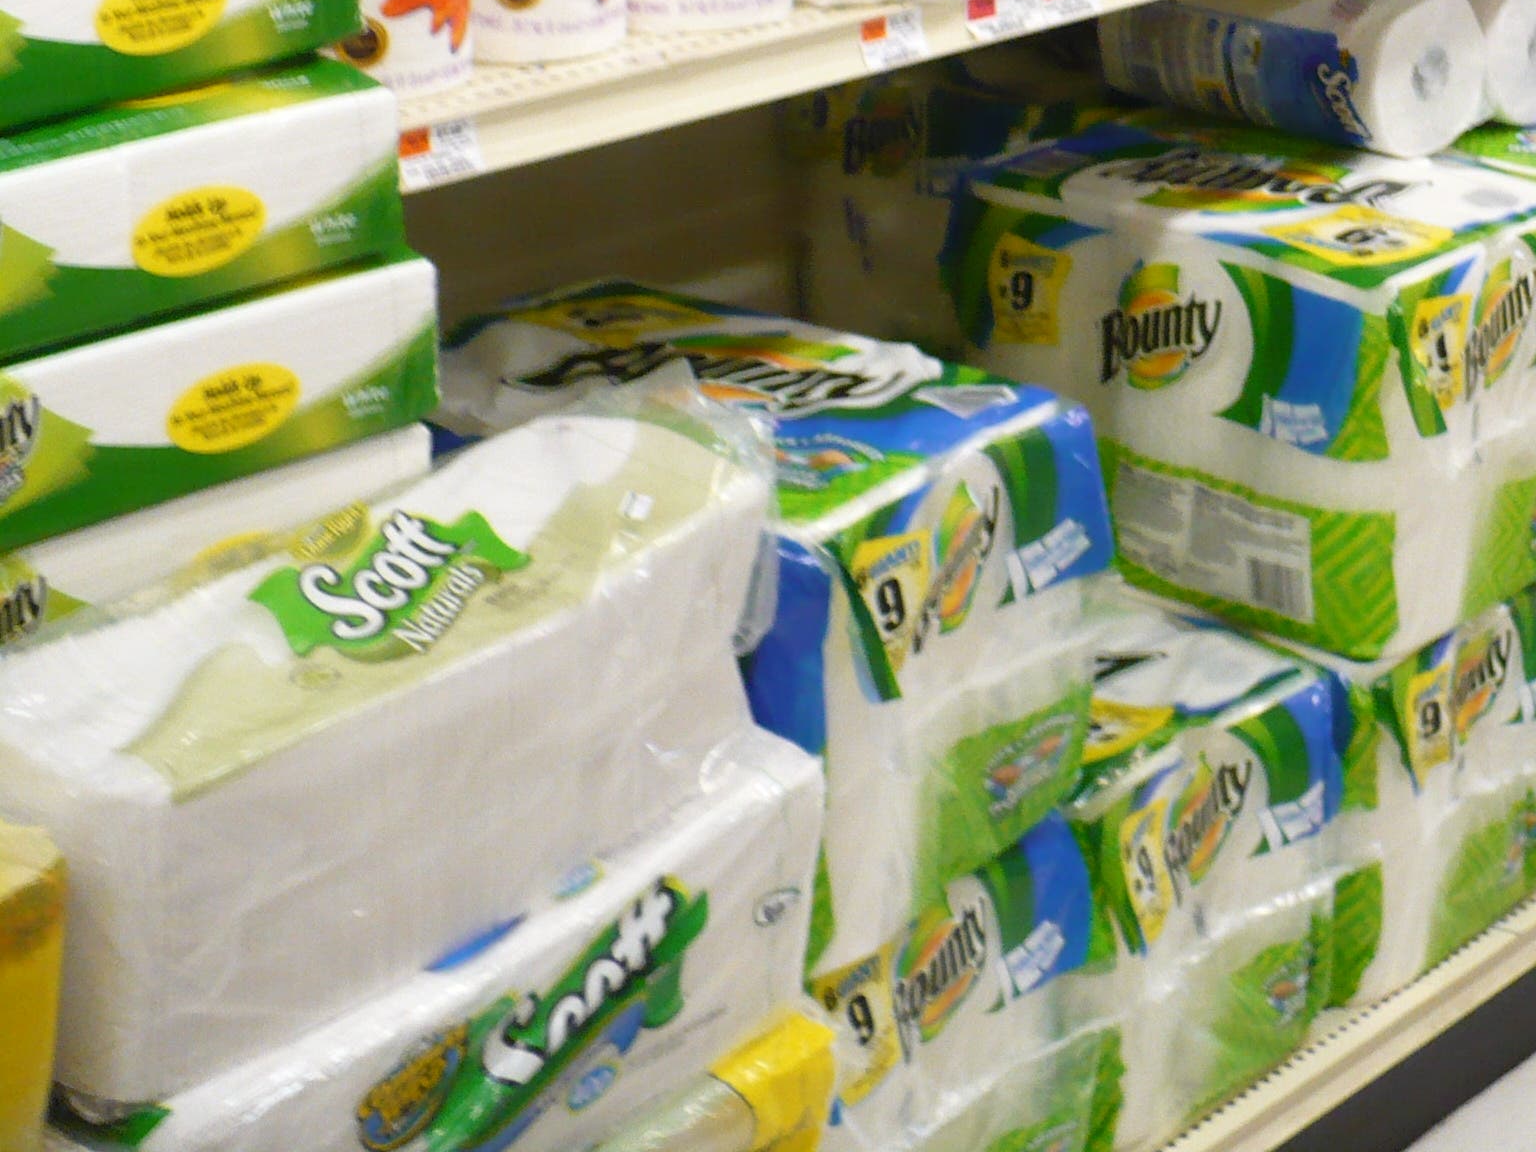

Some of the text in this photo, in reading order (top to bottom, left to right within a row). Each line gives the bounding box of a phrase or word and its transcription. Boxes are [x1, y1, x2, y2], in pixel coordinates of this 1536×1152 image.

[1009, 269, 1034, 313] 9
[1101, 299, 1222, 385] Bounty
[299, 508, 457, 641] Scott
[392, 560, 486, 656] Naturals
[874, 576, 905, 633] 9
[1420, 701, 1441, 740] 9
[1165, 759, 1252, 905] Bounty
[845, 993, 875, 1044] 9
